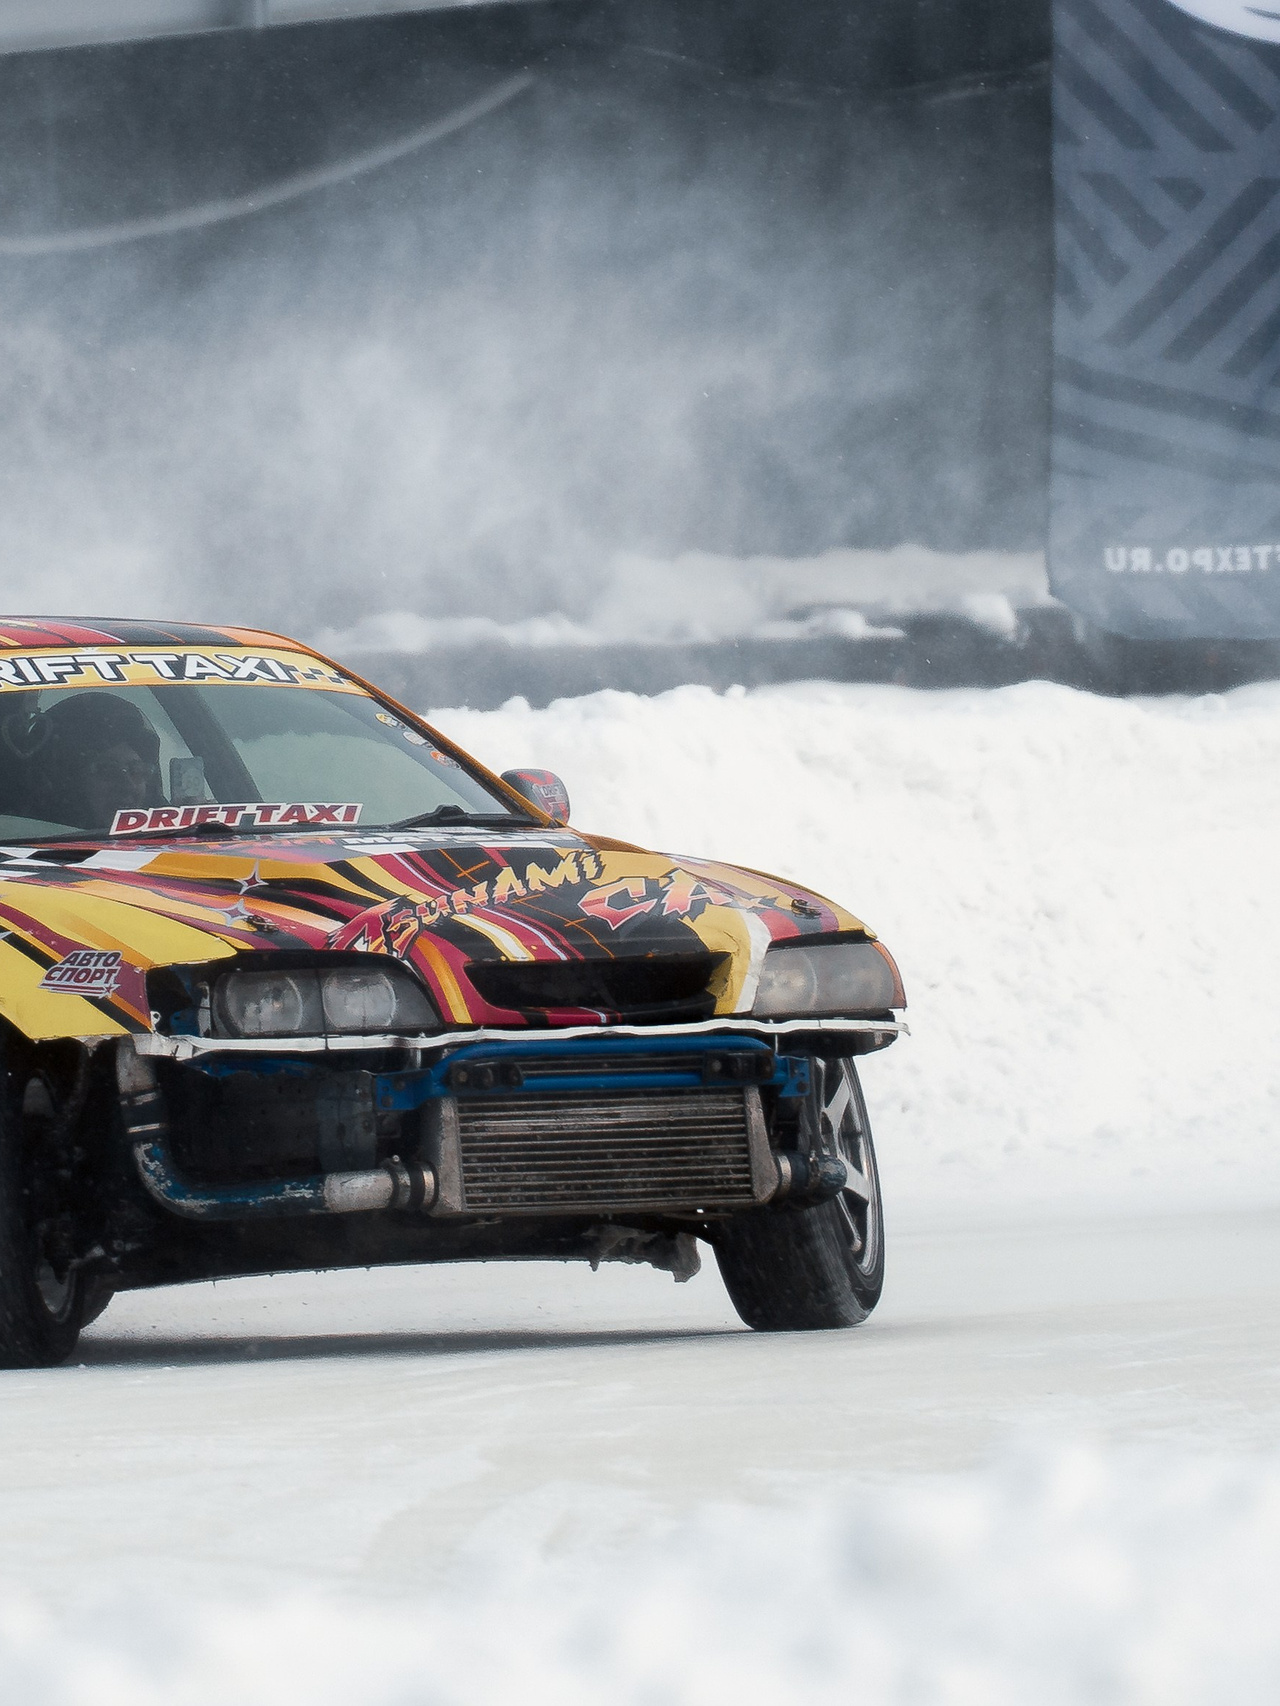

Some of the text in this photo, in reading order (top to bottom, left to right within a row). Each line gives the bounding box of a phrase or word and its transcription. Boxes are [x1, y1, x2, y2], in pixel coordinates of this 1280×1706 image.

[131, 653, 297, 684] TAXI
[115, 804, 361, 832] DRIFT TAXI
[58, 952, 122, 967] АВТО
[44, 966, 119, 984] СПОРТ
